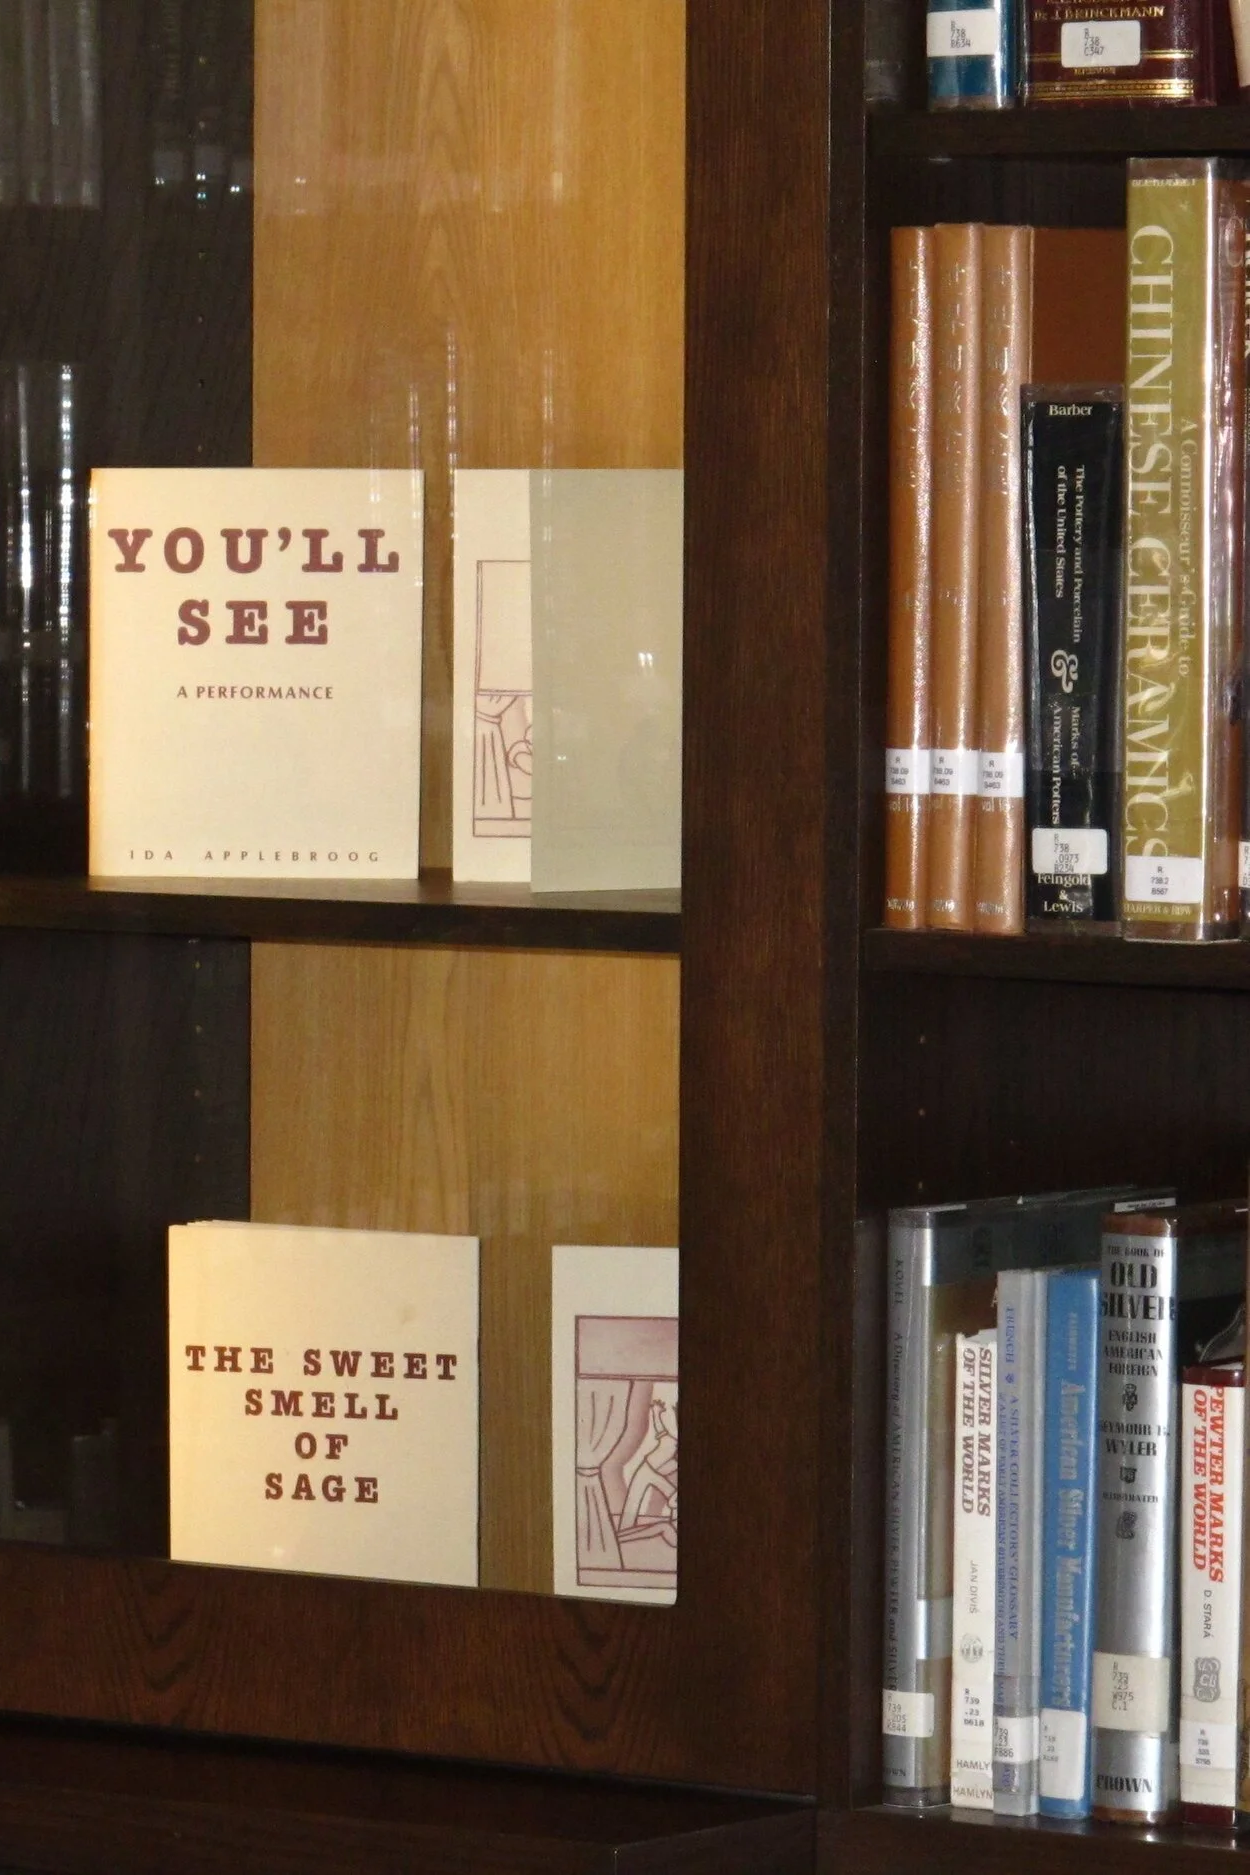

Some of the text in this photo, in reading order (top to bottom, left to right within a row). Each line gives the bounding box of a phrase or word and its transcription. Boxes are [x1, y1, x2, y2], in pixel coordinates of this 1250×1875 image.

[1065, 6, 1165, 20] BRINCKMANN
[1129, 224, 1174, 518] CHINESE
[1049, 404, 1093, 416] Barber
[1181, 417, 1198, 433] A
[1055, 465, 1067, 599] of the United States
[1072, 464, 1086, 644] The Pottery and Porcelain
[178, 599, 328, 646] SEE
[1050, 649, 1079, 694] &
[1179, 656, 1194, 677] to
[177, 686, 333, 699] A PERFORMANCE
[1125, 537, 1172, 857] CERAMICS
[1070, 705, 1082, 750] Marks
[1051, 707, 1063, 825] American Potters
[130, 850, 379, 862] IDA APPLEBROOG
[1054, 843, 1070, 853] 738
[1055, 853, 1079, 864] .0973
[1037, 873, 1092, 887] Feingold
[1043, 901, 1084, 912] Lewis
[1059, 890, 1069, 900] &
[1124, 903, 1192, 915] HARPER & ROW
[1107, 1245, 1122, 1255] THE
[1124, 1246, 1149, 1257] BOOK
[1110, 1261, 1158, 1288] OLD
[1099, 1294, 1177, 1321] SILVER
[1005, 1306, 1015, 1364] FRENCH
[1108, 1330, 1157, 1344] ENGLISH
[185, 1345, 458, 1380] THE SWEET
[1104, 1346, 1164, 1360] AMERICAN
[1108, 1362, 1158, 1377] FOREIGN
[244, 1388, 399, 1421] SMELL
[1008, 1395, 1019, 1404] A
[961, 1347, 975, 1514] OF THE WORLD
[977, 1347, 992, 1517] SILVER MARKS
[1008, 1408, 1020, 1458] SILVER
[1060, 1378, 1086, 1480] American
[294, 1432, 349, 1460] OF
[1105, 1438, 1157, 1457] WYLER
[264, 1473, 379, 1504] SAGE
[1192, 1389, 1208, 1571] OF THE WORLD
[1208, 1387, 1225, 1583] PEWTER MARKS
[1058, 1487, 1084, 1551] Silver
[970, 1560, 978, 1583] JAN
[1008, 1566, 1020, 1641] GLOSSARY
[888, 1618, 899, 1641] and
[888, 1646, 899, 1691] SILVER
[1112, 1672, 1129, 1681] 739
[1112, 1691, 1134, 1701] W975
[953, 1788, 993, 1800] HAMLYN
[1096, 1775, 1153, 1793] CROWN
